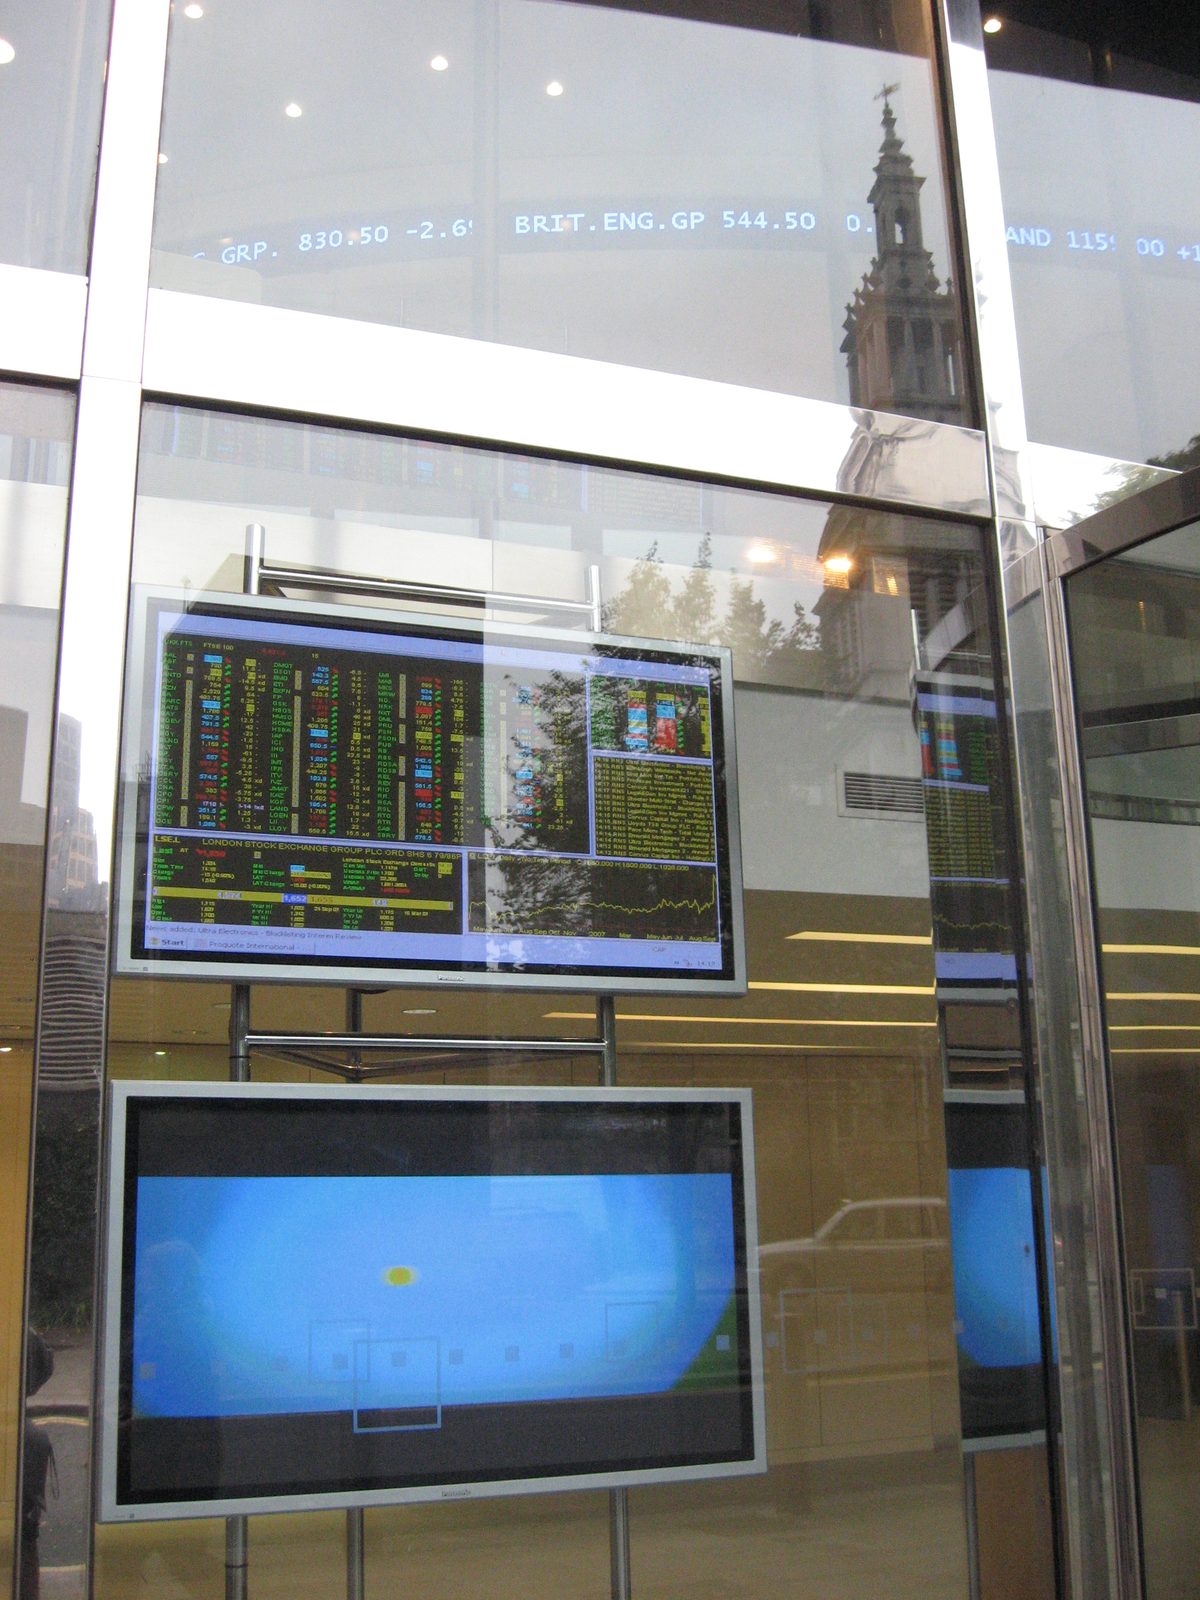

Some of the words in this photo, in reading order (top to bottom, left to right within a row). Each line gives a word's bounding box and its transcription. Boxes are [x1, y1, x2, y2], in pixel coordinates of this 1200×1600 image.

[722, 210, 816, 231] 544.50
[221, 241, 277, 264] GRP.
[298, 225, 389, 251] 830.50
[202, 838, 243, 847] LONDON
[245, 841, 276, 849] STOCK
[279, 843, 329, 852] EXCHANGE
[247, 942, 295, 951] International
